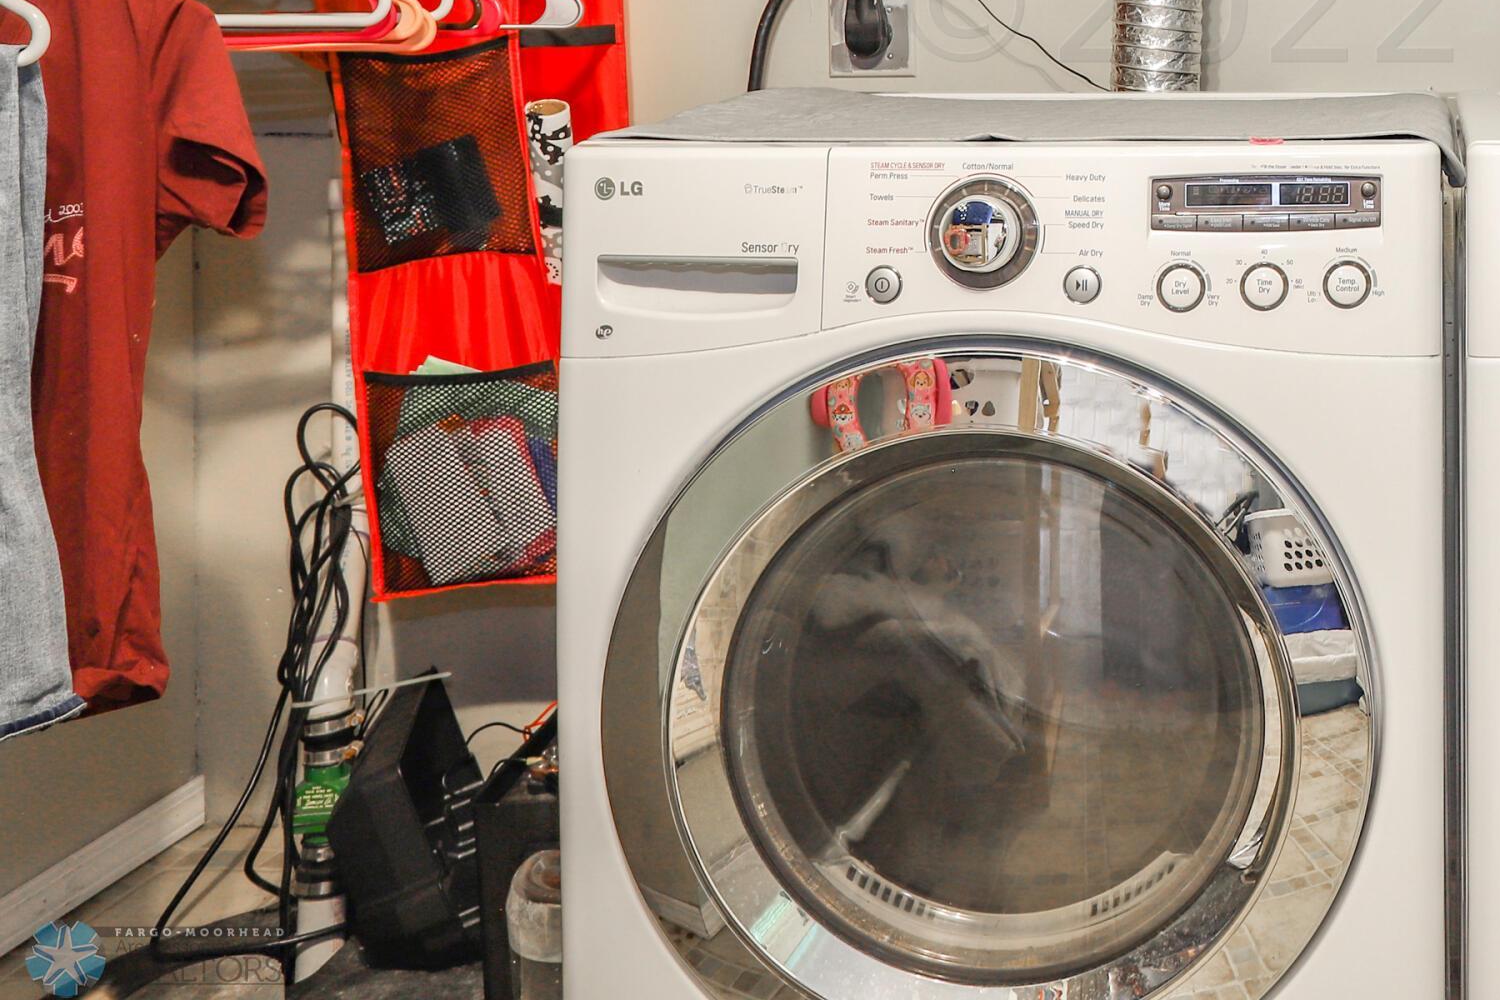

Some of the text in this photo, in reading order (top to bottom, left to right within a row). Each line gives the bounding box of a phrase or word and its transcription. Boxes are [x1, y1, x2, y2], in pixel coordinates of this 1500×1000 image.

[962, 162, 1014, 170] Cotton/Normal
[889, 172, 908, 180] Press
[1065, 173, 1106, 182] Heavy Duty
[870, 193, 894, 201] Towels
[867, 218, 889, 226] Steam
[1068, 221, 1104, 230] Speed Dry
[741, 241, 800, 255] Sensor ry
[1090, 249, 1104, 258] Dry
[1258, 286, 1271, 294] Dry
[1335, 285, 1360, 293] Control
[1137, 293, 1153, 301] Damp
